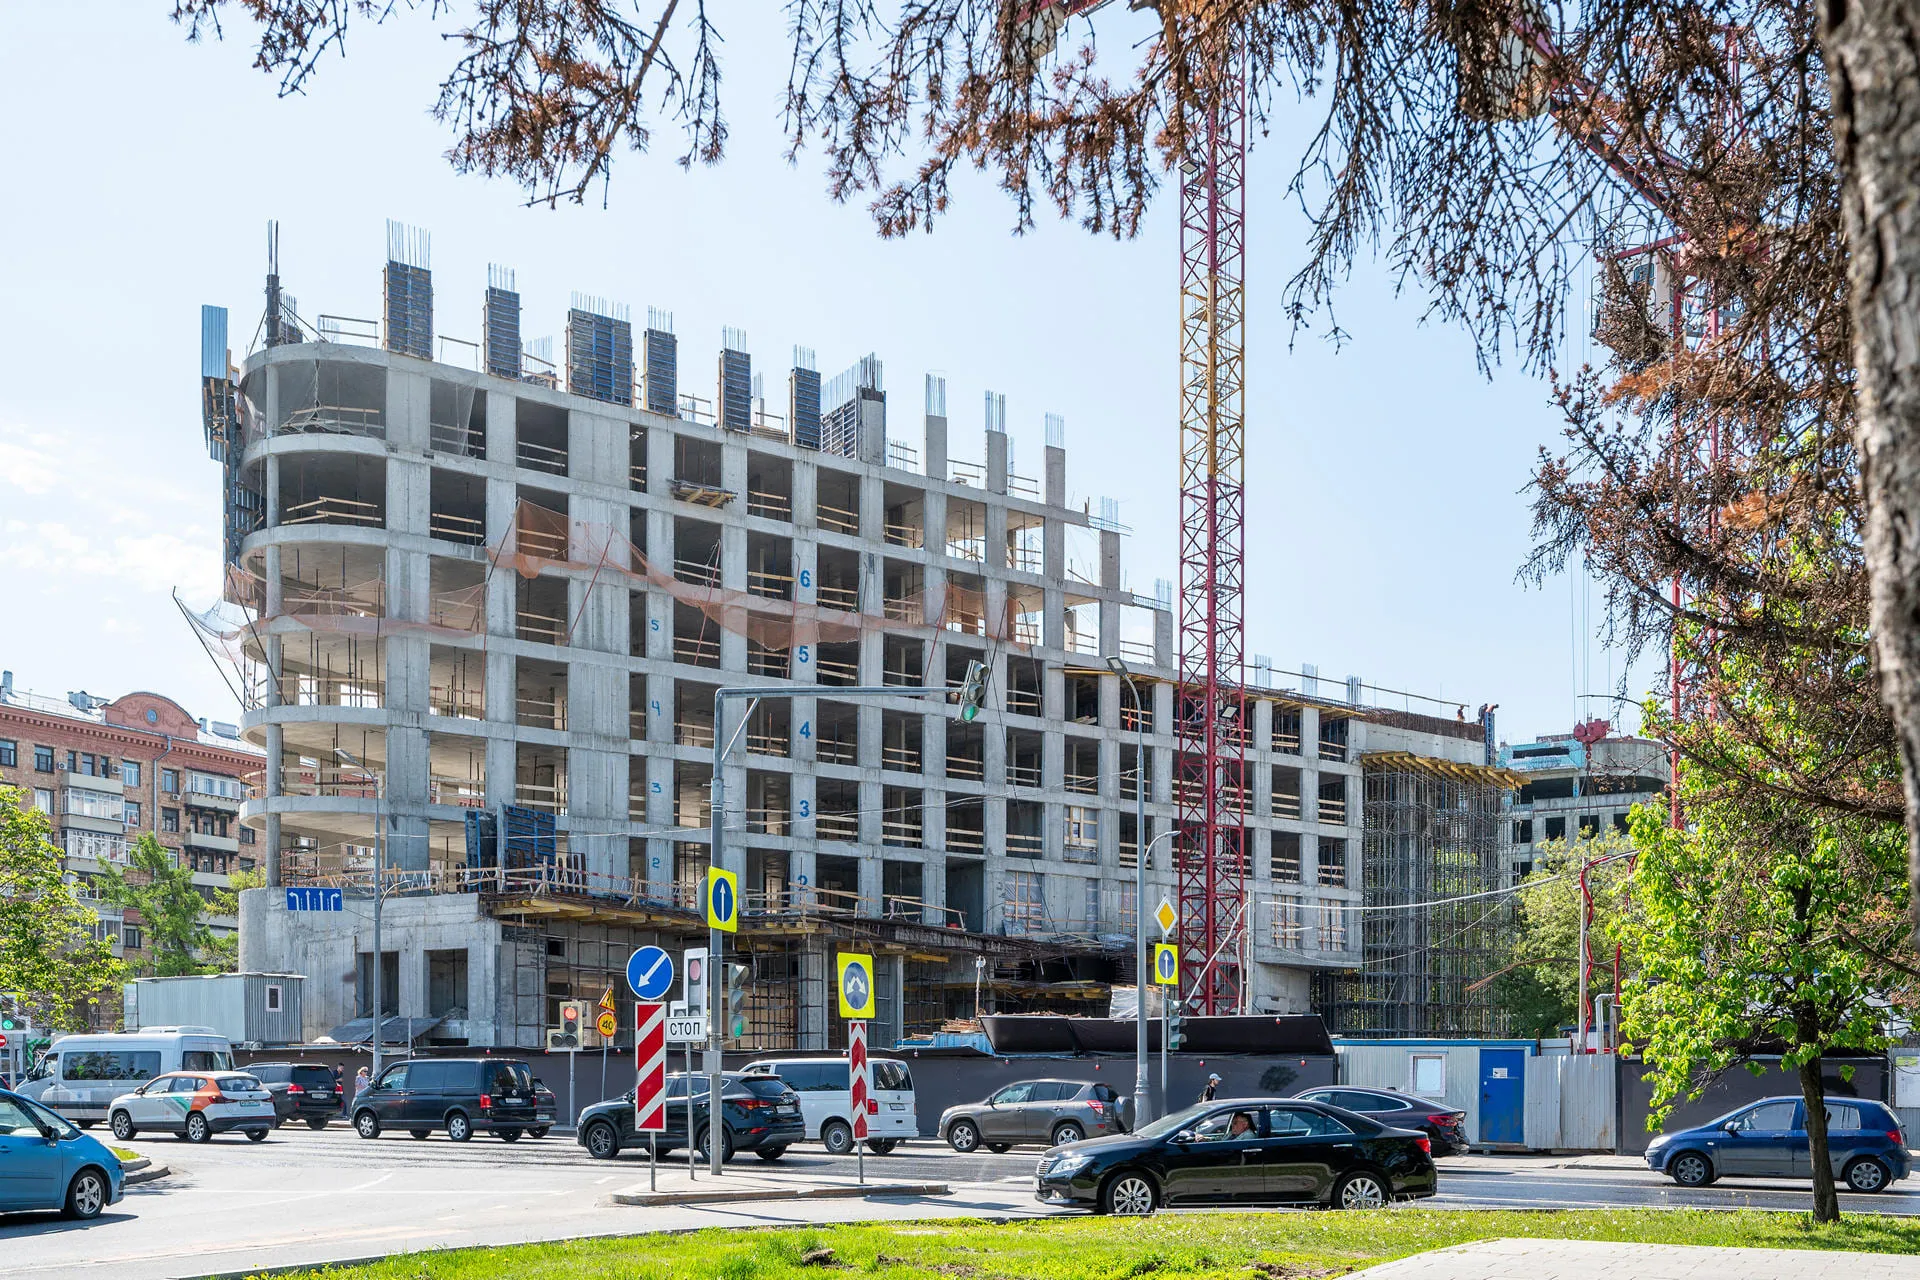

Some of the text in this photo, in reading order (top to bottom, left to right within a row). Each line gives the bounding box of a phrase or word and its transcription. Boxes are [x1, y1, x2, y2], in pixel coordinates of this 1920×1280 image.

[800, 569, 811, 588] 6
[651, 619, 660, 631] 5
[798, 645, 809, 663] 5
[651, 700, 661, 716] 4
[799, 720, 811, 739] 4
[651, 782, 662, 793] 3
[799, 799, 810, 818] 3
[652, 857, 660, 869] 2
[797, 875, 808, 891] 2
[602, 1020, 614, 1031] 40
[670, 1022, 701, 1036] СТОП
